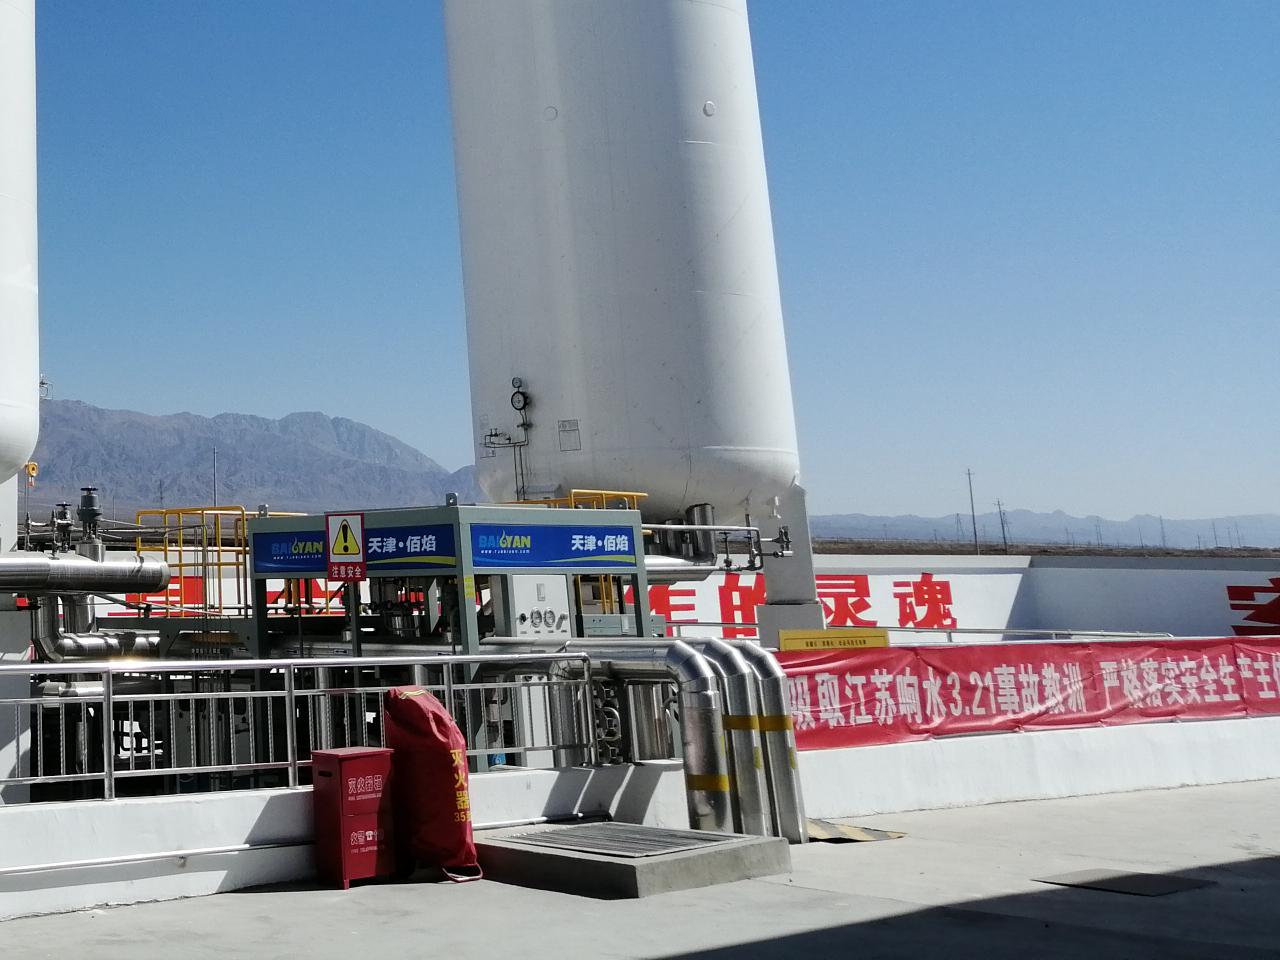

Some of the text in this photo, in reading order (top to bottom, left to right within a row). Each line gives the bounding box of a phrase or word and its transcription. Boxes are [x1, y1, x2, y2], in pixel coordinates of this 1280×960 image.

[368, 534, 436, 554] 天津·佰焰
[571, 534, 629, 552] 天津·佰焰
[331, 565, 362, 578] 注意安全
